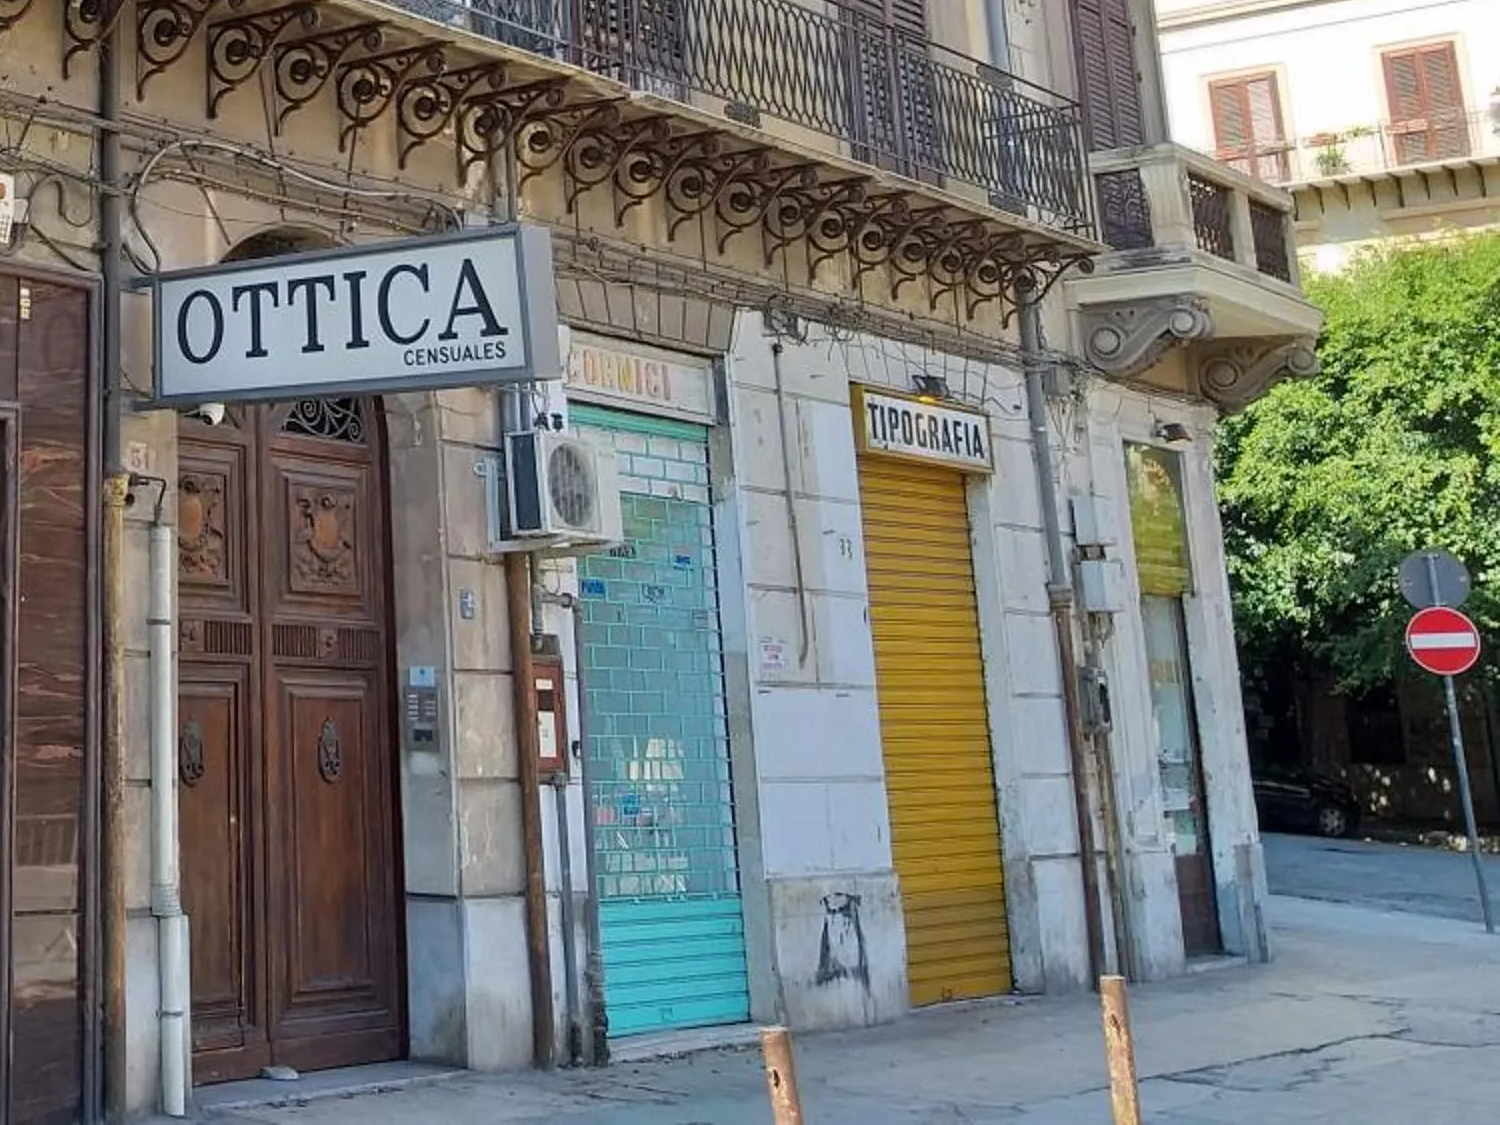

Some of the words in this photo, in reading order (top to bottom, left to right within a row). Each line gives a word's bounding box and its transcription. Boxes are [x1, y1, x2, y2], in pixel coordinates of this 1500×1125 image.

[177, 258, 508, 364] OTTICA
[404, 341, 506, 366] CENSUALES
[868, 401, 985, 459] TIPOGRAFIA
